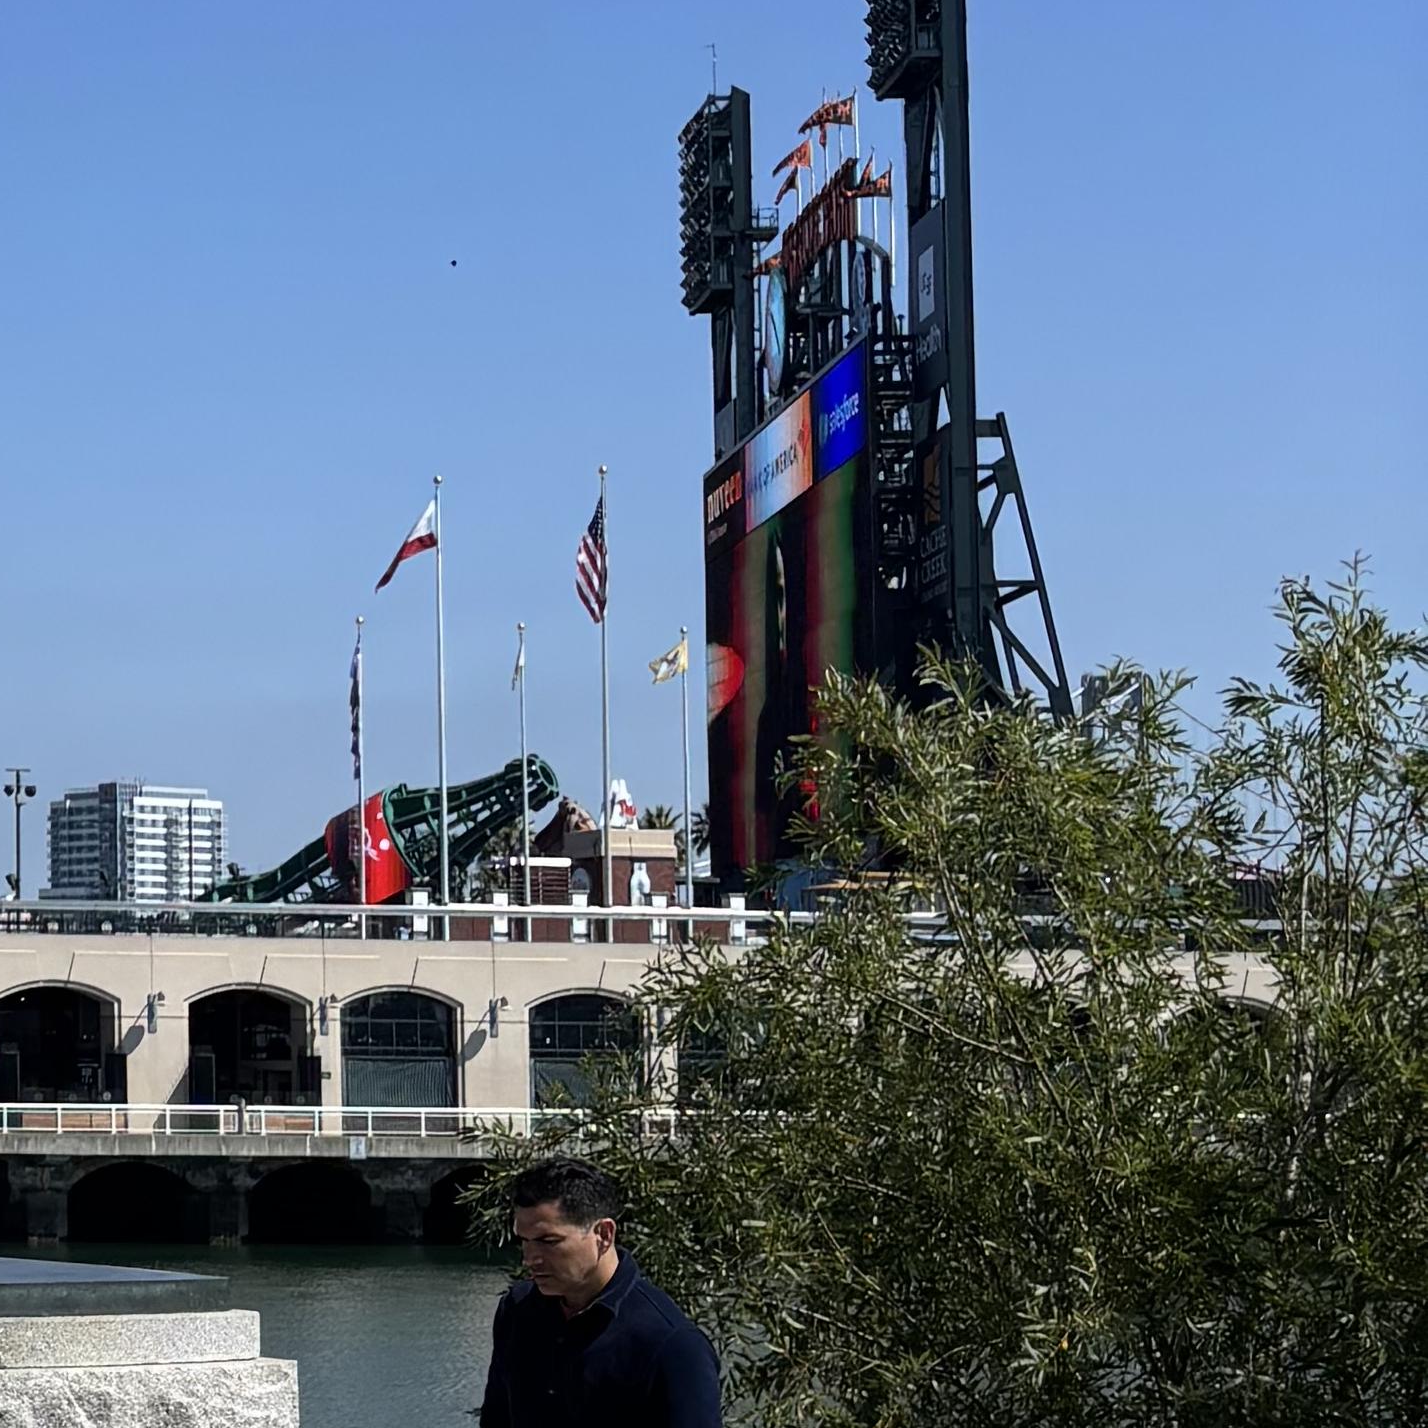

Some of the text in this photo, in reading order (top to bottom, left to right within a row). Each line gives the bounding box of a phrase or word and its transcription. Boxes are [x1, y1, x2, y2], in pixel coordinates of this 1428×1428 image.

[916, 323, 942, 366] Health
[829, 392, 860, 436] salesforce
[771, 442, 799, 485] AMERICA
